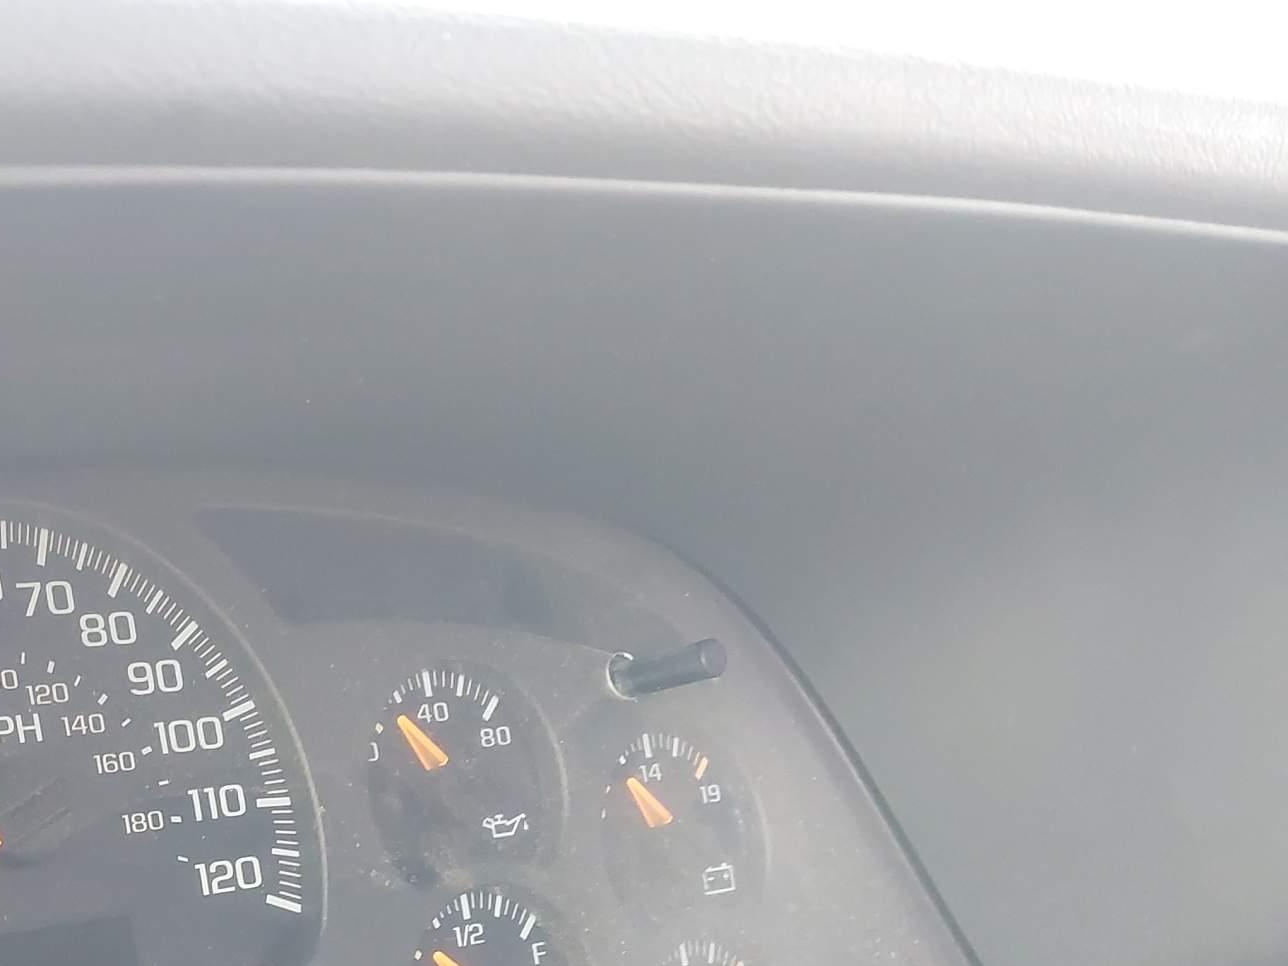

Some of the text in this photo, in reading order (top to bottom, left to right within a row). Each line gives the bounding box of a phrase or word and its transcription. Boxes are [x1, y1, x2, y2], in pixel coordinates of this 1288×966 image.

[17, 579, 74, 616] 70
[80, 612, 136, 646] 80
[128, 660, 182, 694] 90
[26, 683, 68, 705] 120
[417, 702, 449, 722] 40
[61, 714, 105, 735] 140
[154, 717, 224, 754] 100
[480, 726, 511, 747] 80
[94, 752, 135, 774] 160
[639, 763, 662, 782] 14
[189, 784, 246, 821] 110
[699, 784, 721, 803] 19
[122, 810, 164, 833] 180
[195, 856, 262, 895] 120
[453, 923, 485, 947] 1/2
[532, 942, 546, 965] F
